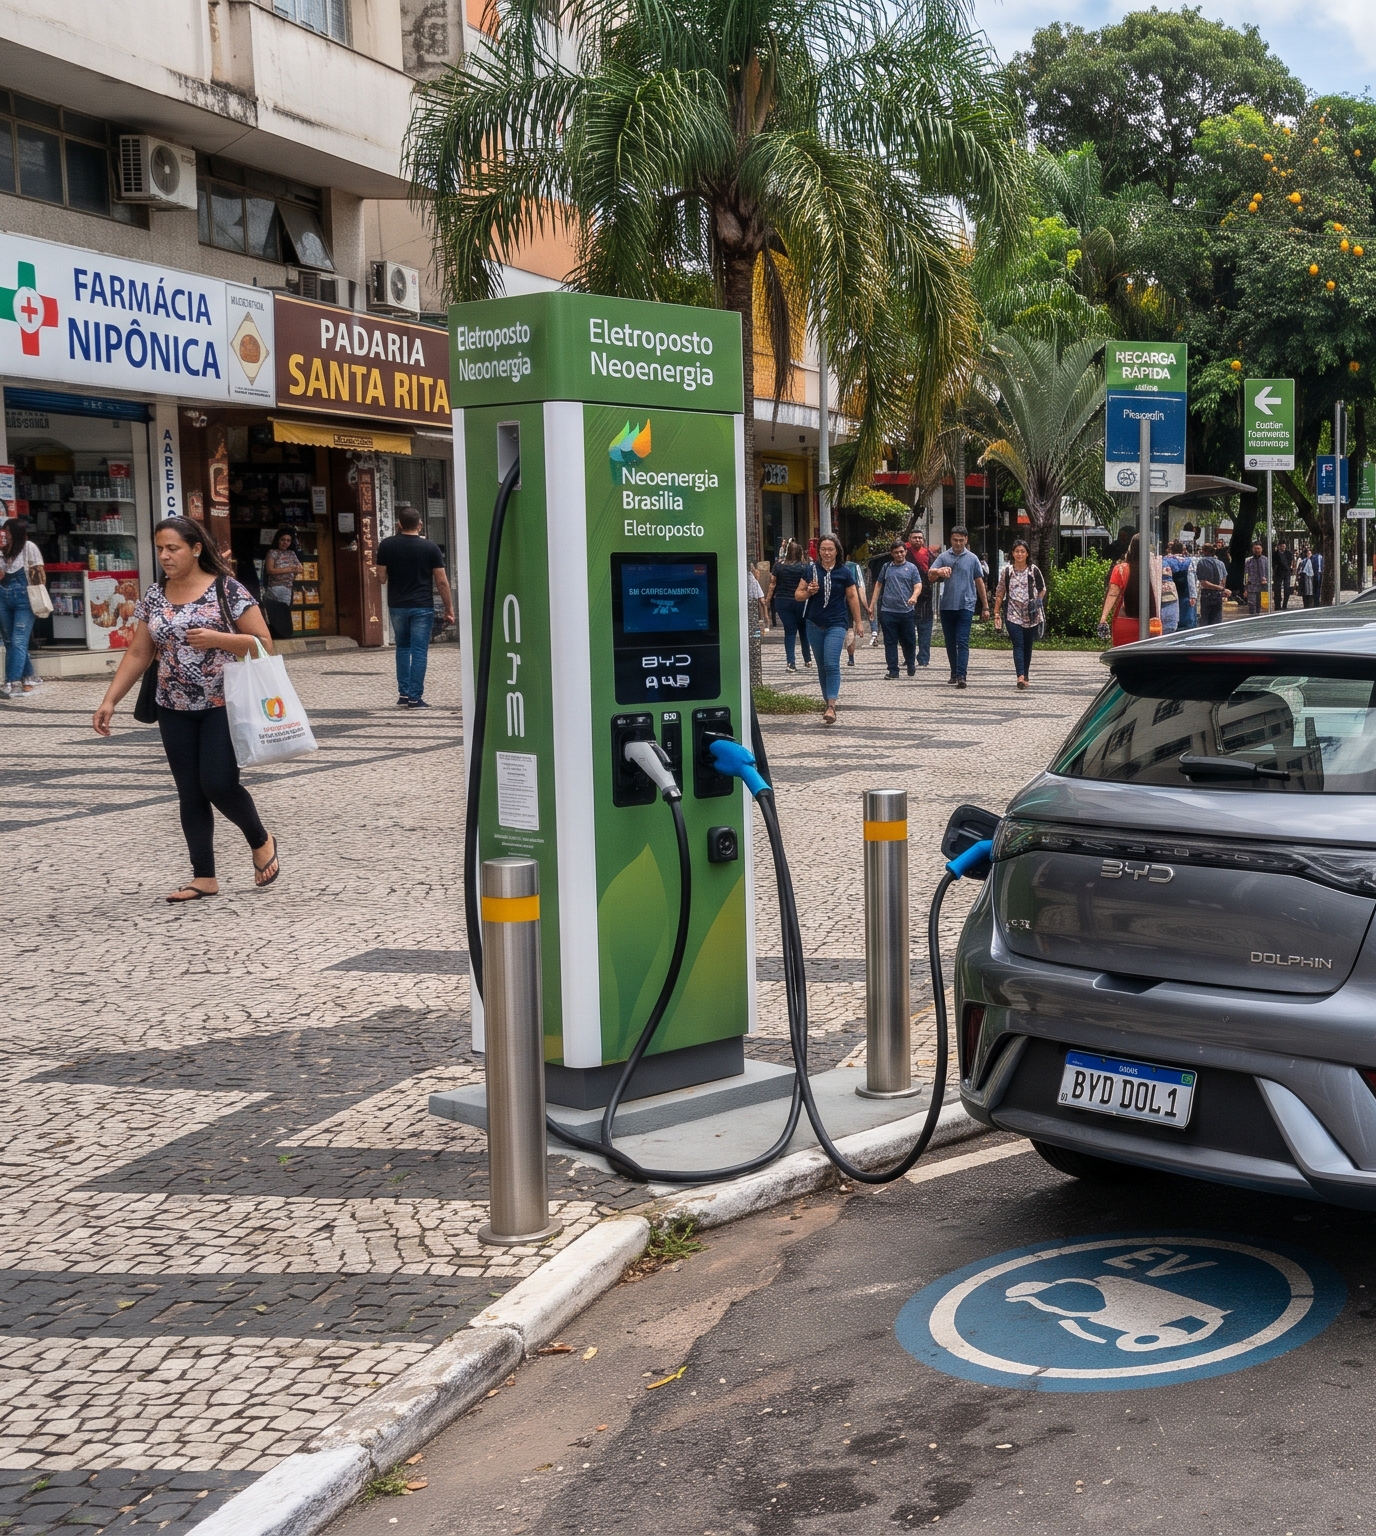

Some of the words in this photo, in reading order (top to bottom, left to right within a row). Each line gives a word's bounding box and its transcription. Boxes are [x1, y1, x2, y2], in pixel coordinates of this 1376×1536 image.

[73, 267, 213, 326] FARMÁCIA
[67, 317, 222, 380] NIPÔNICA
[320, 318, 426, 367] PADARIA
[457, 321, 531, 352] Eletroposto
[589, 318, 714, 356] Eletroposto
[288, 353, 387, 407] SANTA
[394, 371, 451, 415] RITA
[590, 351, 714, 391] Neoenergia
[1122, 365, 1171, 380] RÁPIDA
[621, 467, 719, 492] Neoenergia
[622, 490, 684, 511] Brasilia
[624, 520, 705, 541] Eletroposto
[642, 654, 692, 668] BYD
[1100, 859, 1175, 884] BYD
[1250, 951, 1333, 969] DOLPHIN
[1071, 1070, 1115, 1105] BYD
[1119, 1078, 1178, 1118] DOL1
[1102, 1246, 1219, 1278] EV
